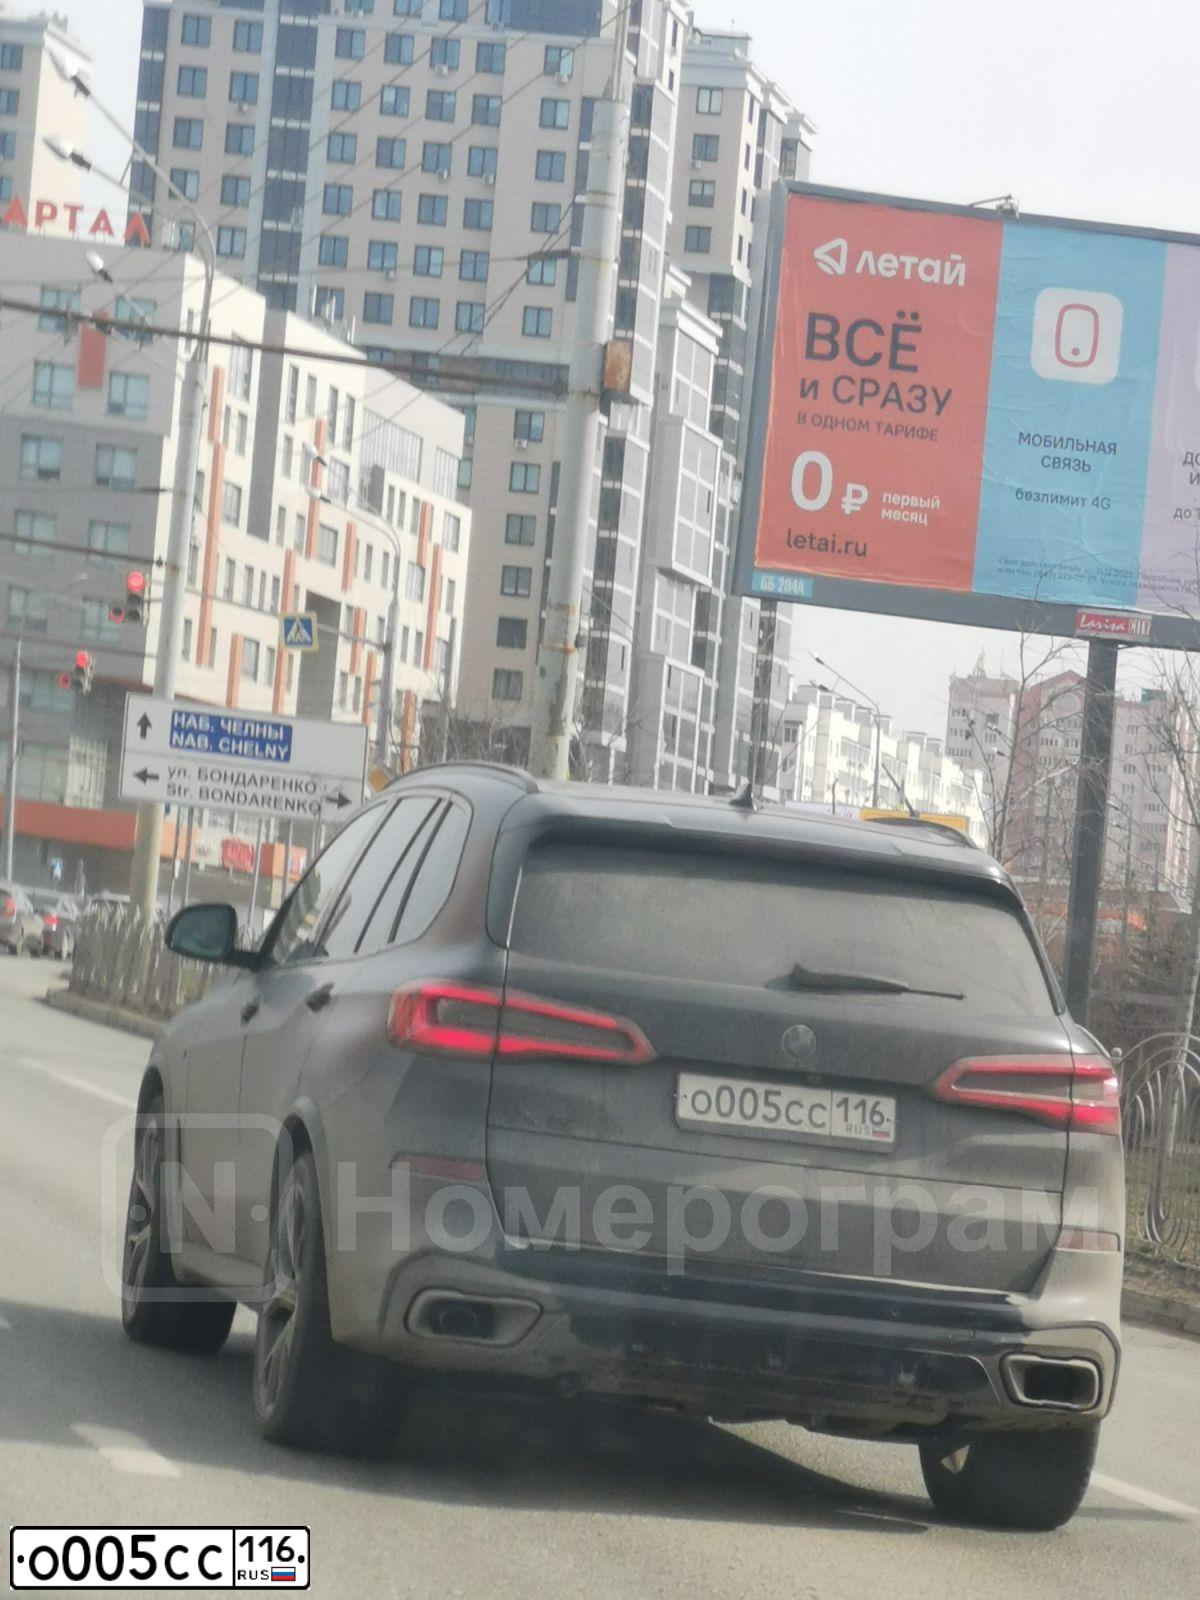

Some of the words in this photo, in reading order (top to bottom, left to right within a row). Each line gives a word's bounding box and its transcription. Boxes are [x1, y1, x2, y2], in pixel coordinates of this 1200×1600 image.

[805, 310, 922, 373] ВСЁ
[832, 375, 952, 416] СРАЗУ
[811, 413, 869, 432] ОДНОМ
[875, 421, 939, 441] ТАРИФЕ
[1018, 432, 1117, 455] МОБИЛЬНАЯ
[1041, 455, 1091, 472] СВЯЗЬ
[791, 450, 833, 511] 0
[882, 491, 940, 509] первый
[1015, 488, 1087, 507] безлимит
[1091, 496, 1111, 510] 4G
[881, 508, 928, 526] месяц
[786, 529, 867, 557] letai.ru
[174, 712, 214, 732] НАБ.
[221, 718, 284, 741] ЧЕЛНЫ
[172, 731, 213, 750] NAB.
[219, 736, 289, 760] CHELNY
[198, 766, 317, 794] БОНДАРЕНКО
[167, 782, 192, 799] Str.
[199, 785, 321, 814] BONDARENKO
[836, 1097, 885, 1127] 116
[846, 1123, 871, 1136] RUS
